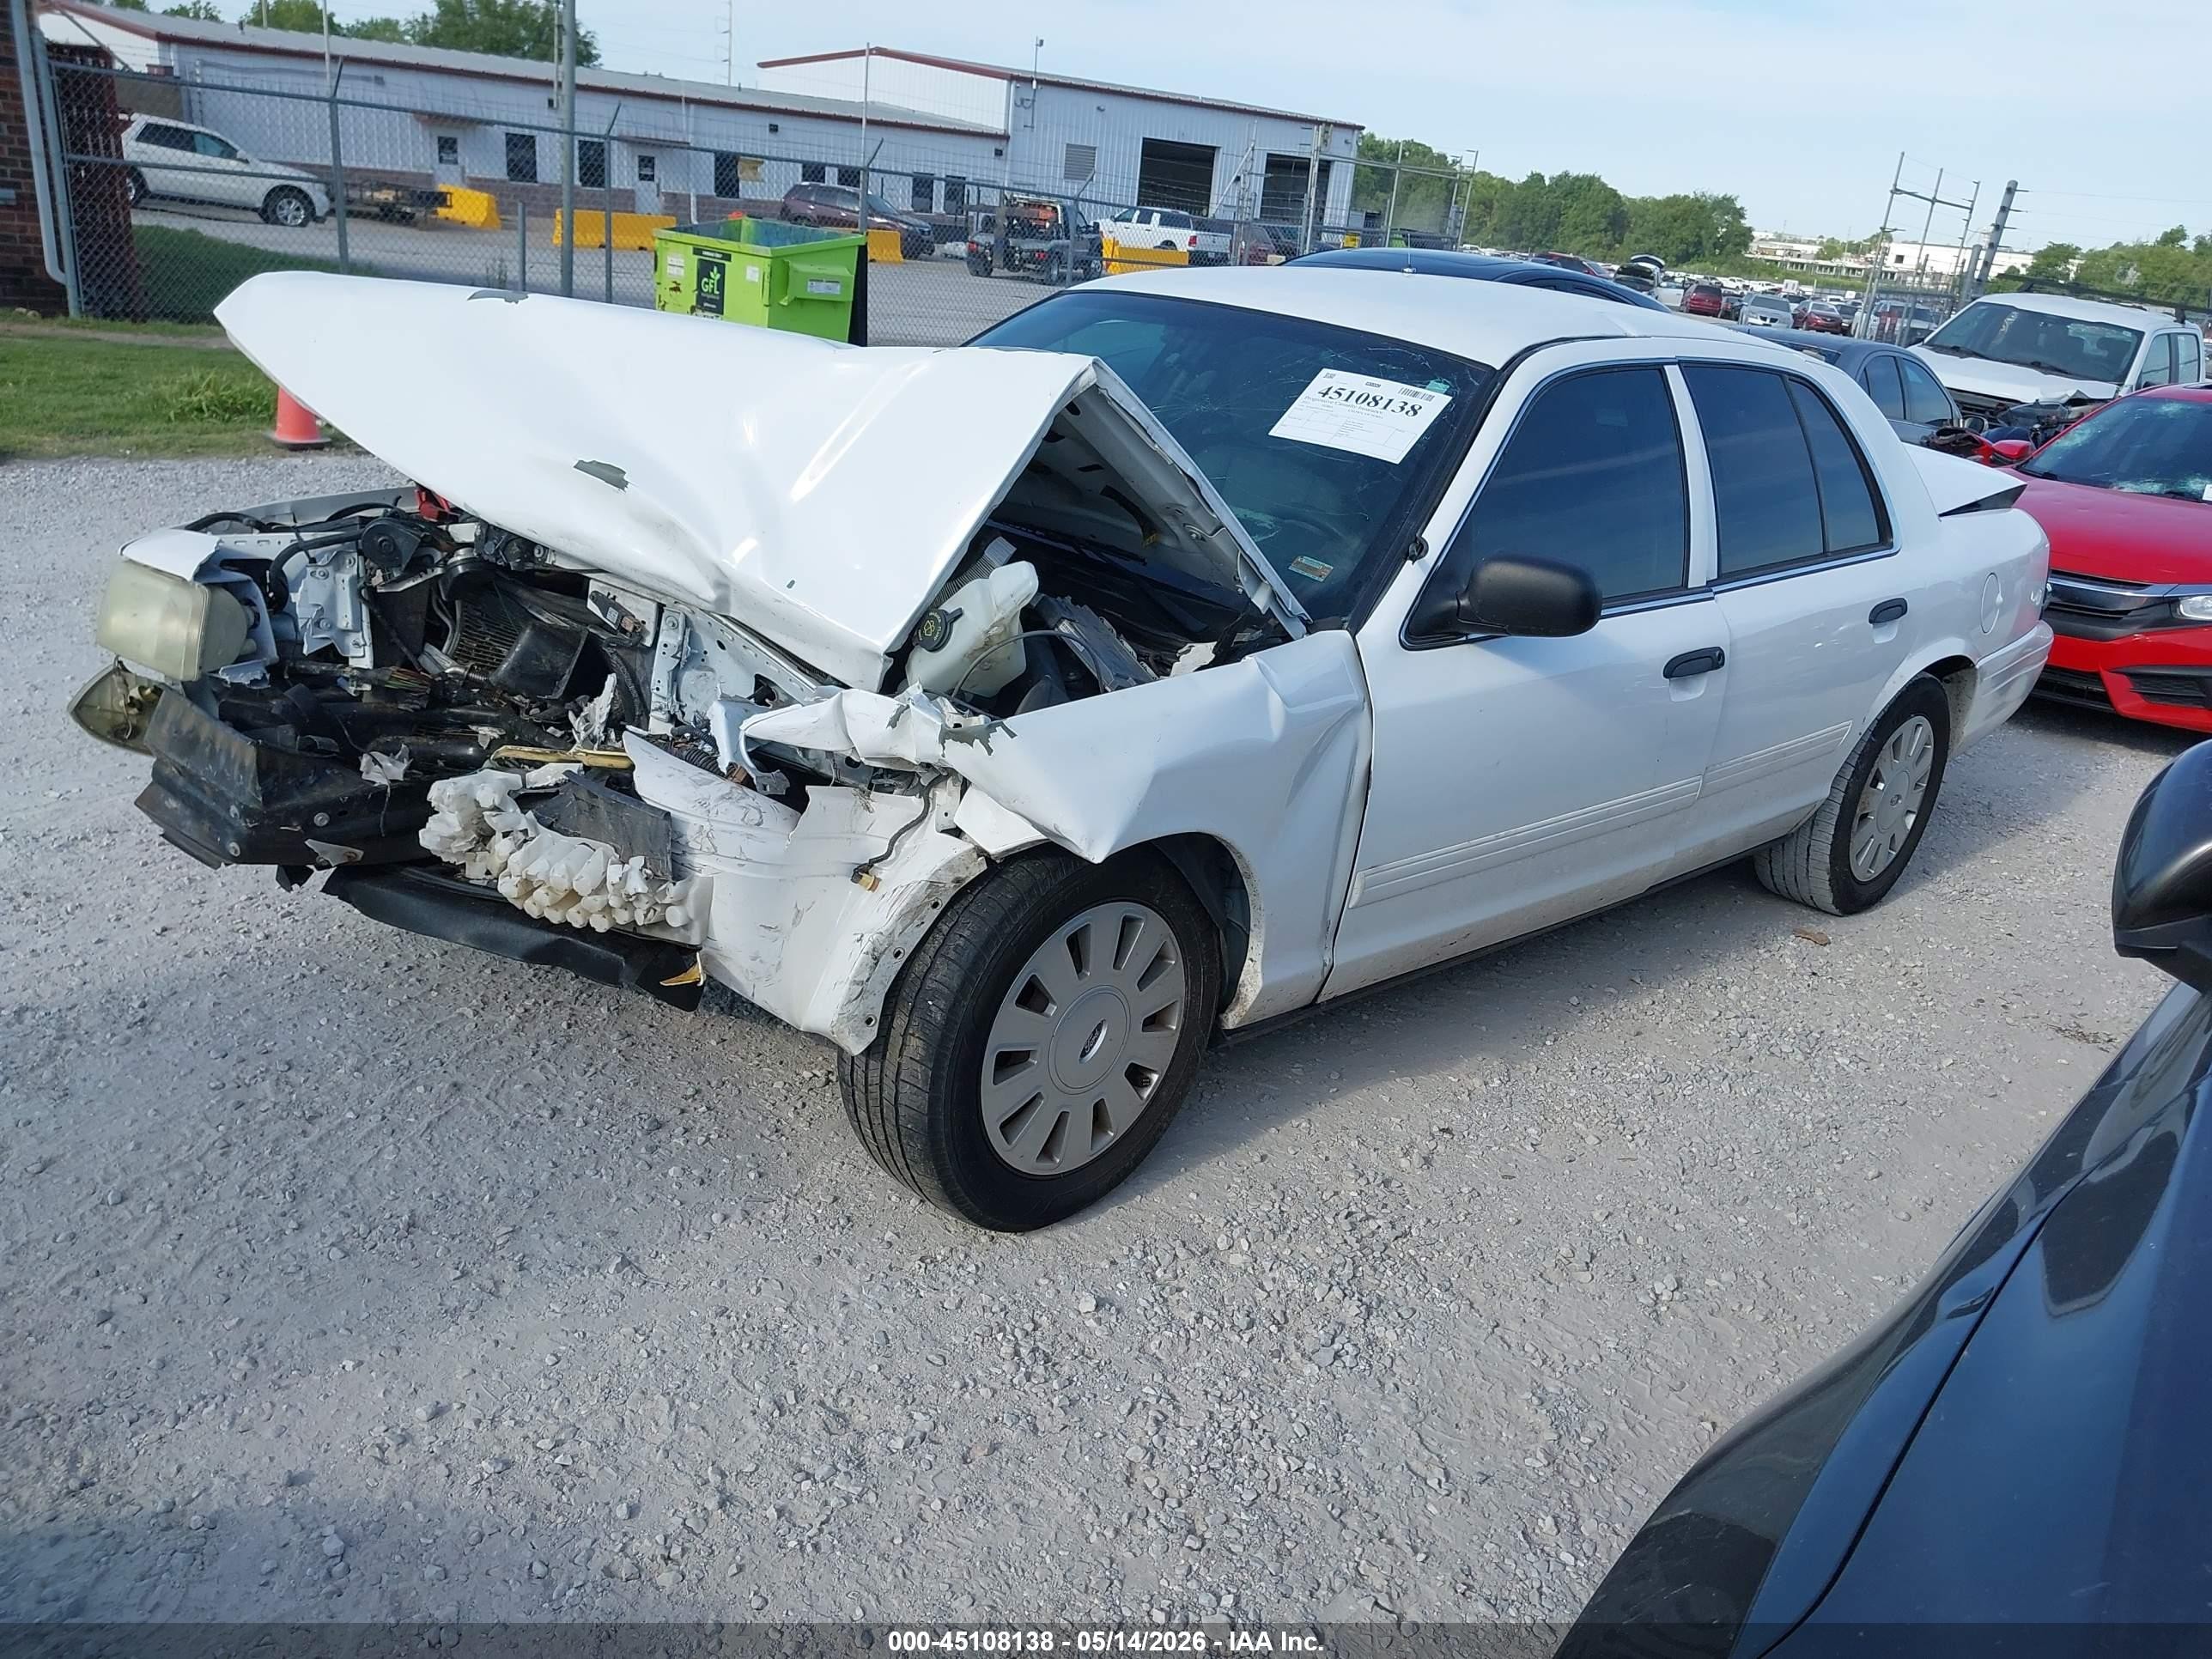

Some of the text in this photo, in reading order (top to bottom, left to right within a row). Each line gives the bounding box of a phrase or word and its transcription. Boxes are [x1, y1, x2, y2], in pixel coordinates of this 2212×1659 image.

[701, 270, 721, 295] GFL
[1304, 396, 1334, 405] Progressive
[1318, 386, 1423, 417] 45108138
